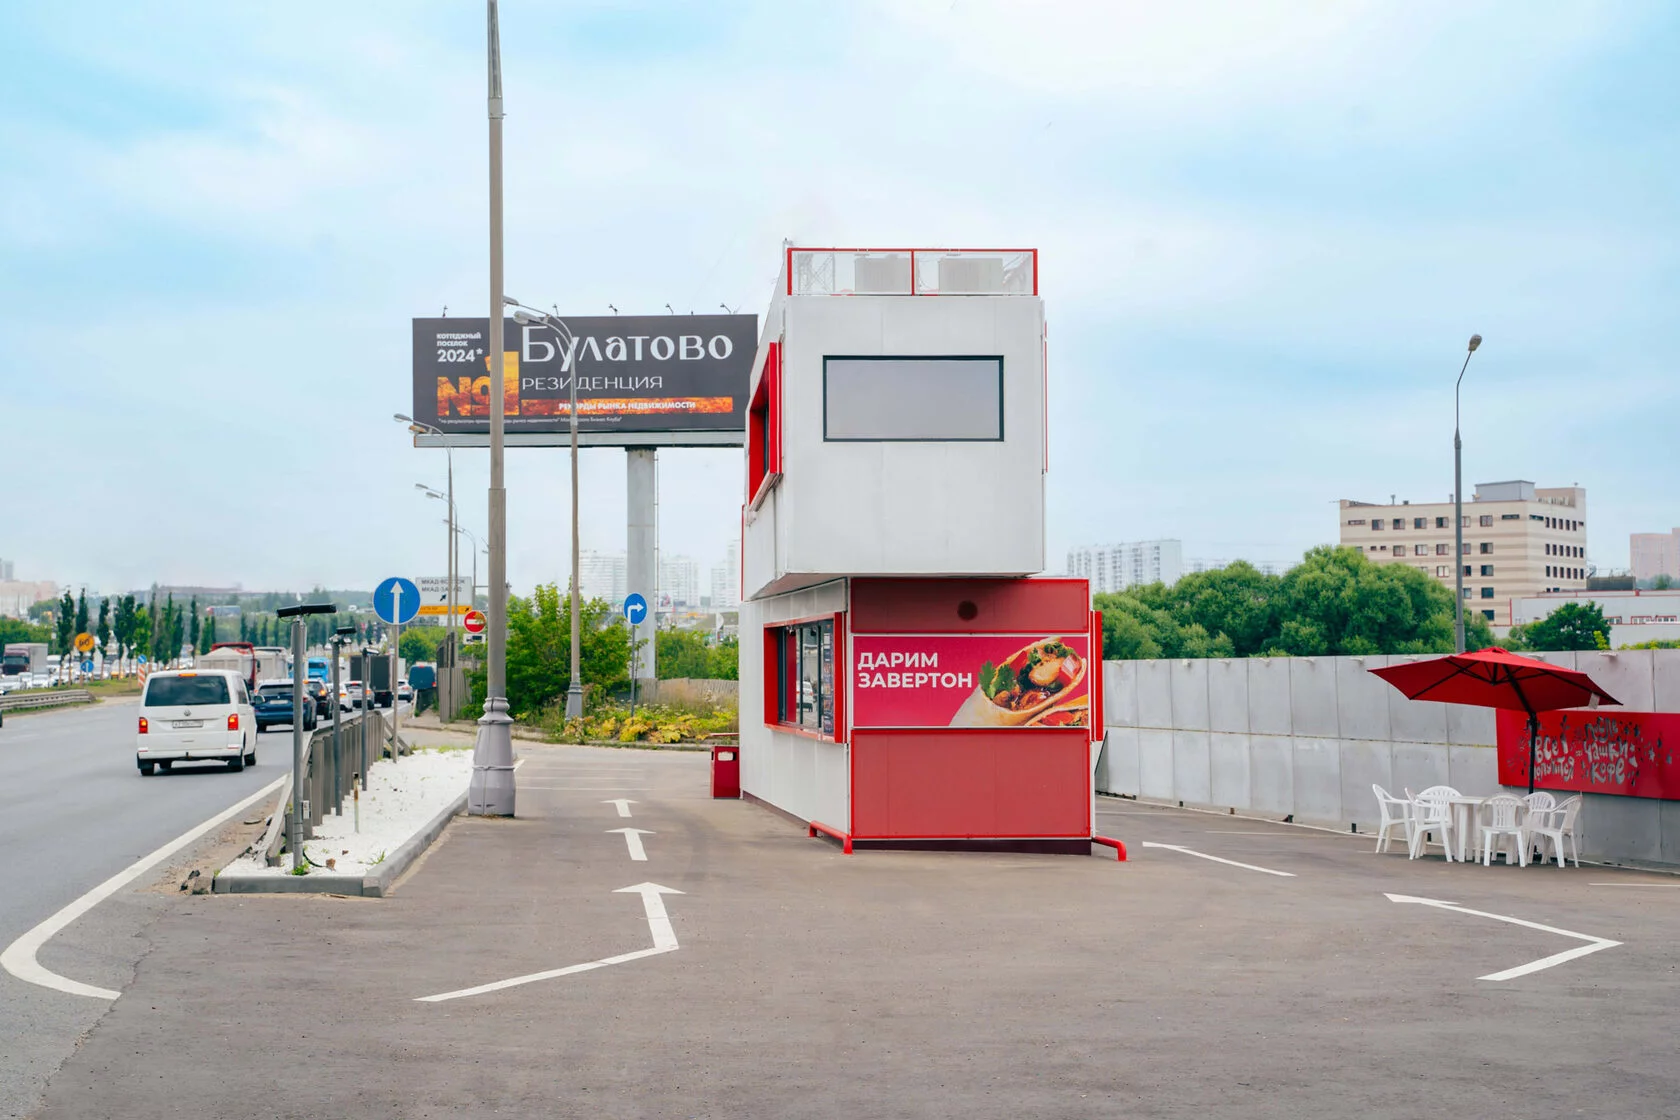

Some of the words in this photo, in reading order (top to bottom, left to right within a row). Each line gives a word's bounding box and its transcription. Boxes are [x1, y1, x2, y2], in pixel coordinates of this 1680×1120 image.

[522, 325, 733, 372] Булатово
[522, 376, 663, 391] РЕЗИДЕНЦИЯ
[597, 402, 626, 410] РЫНКА
[628, 402, 696, 410] НЕДВИЖИМОСТИ
[857, 652, 938, 671] ДАРИМ
[858, 672, 972, 688] ЗАВЕРТОН
